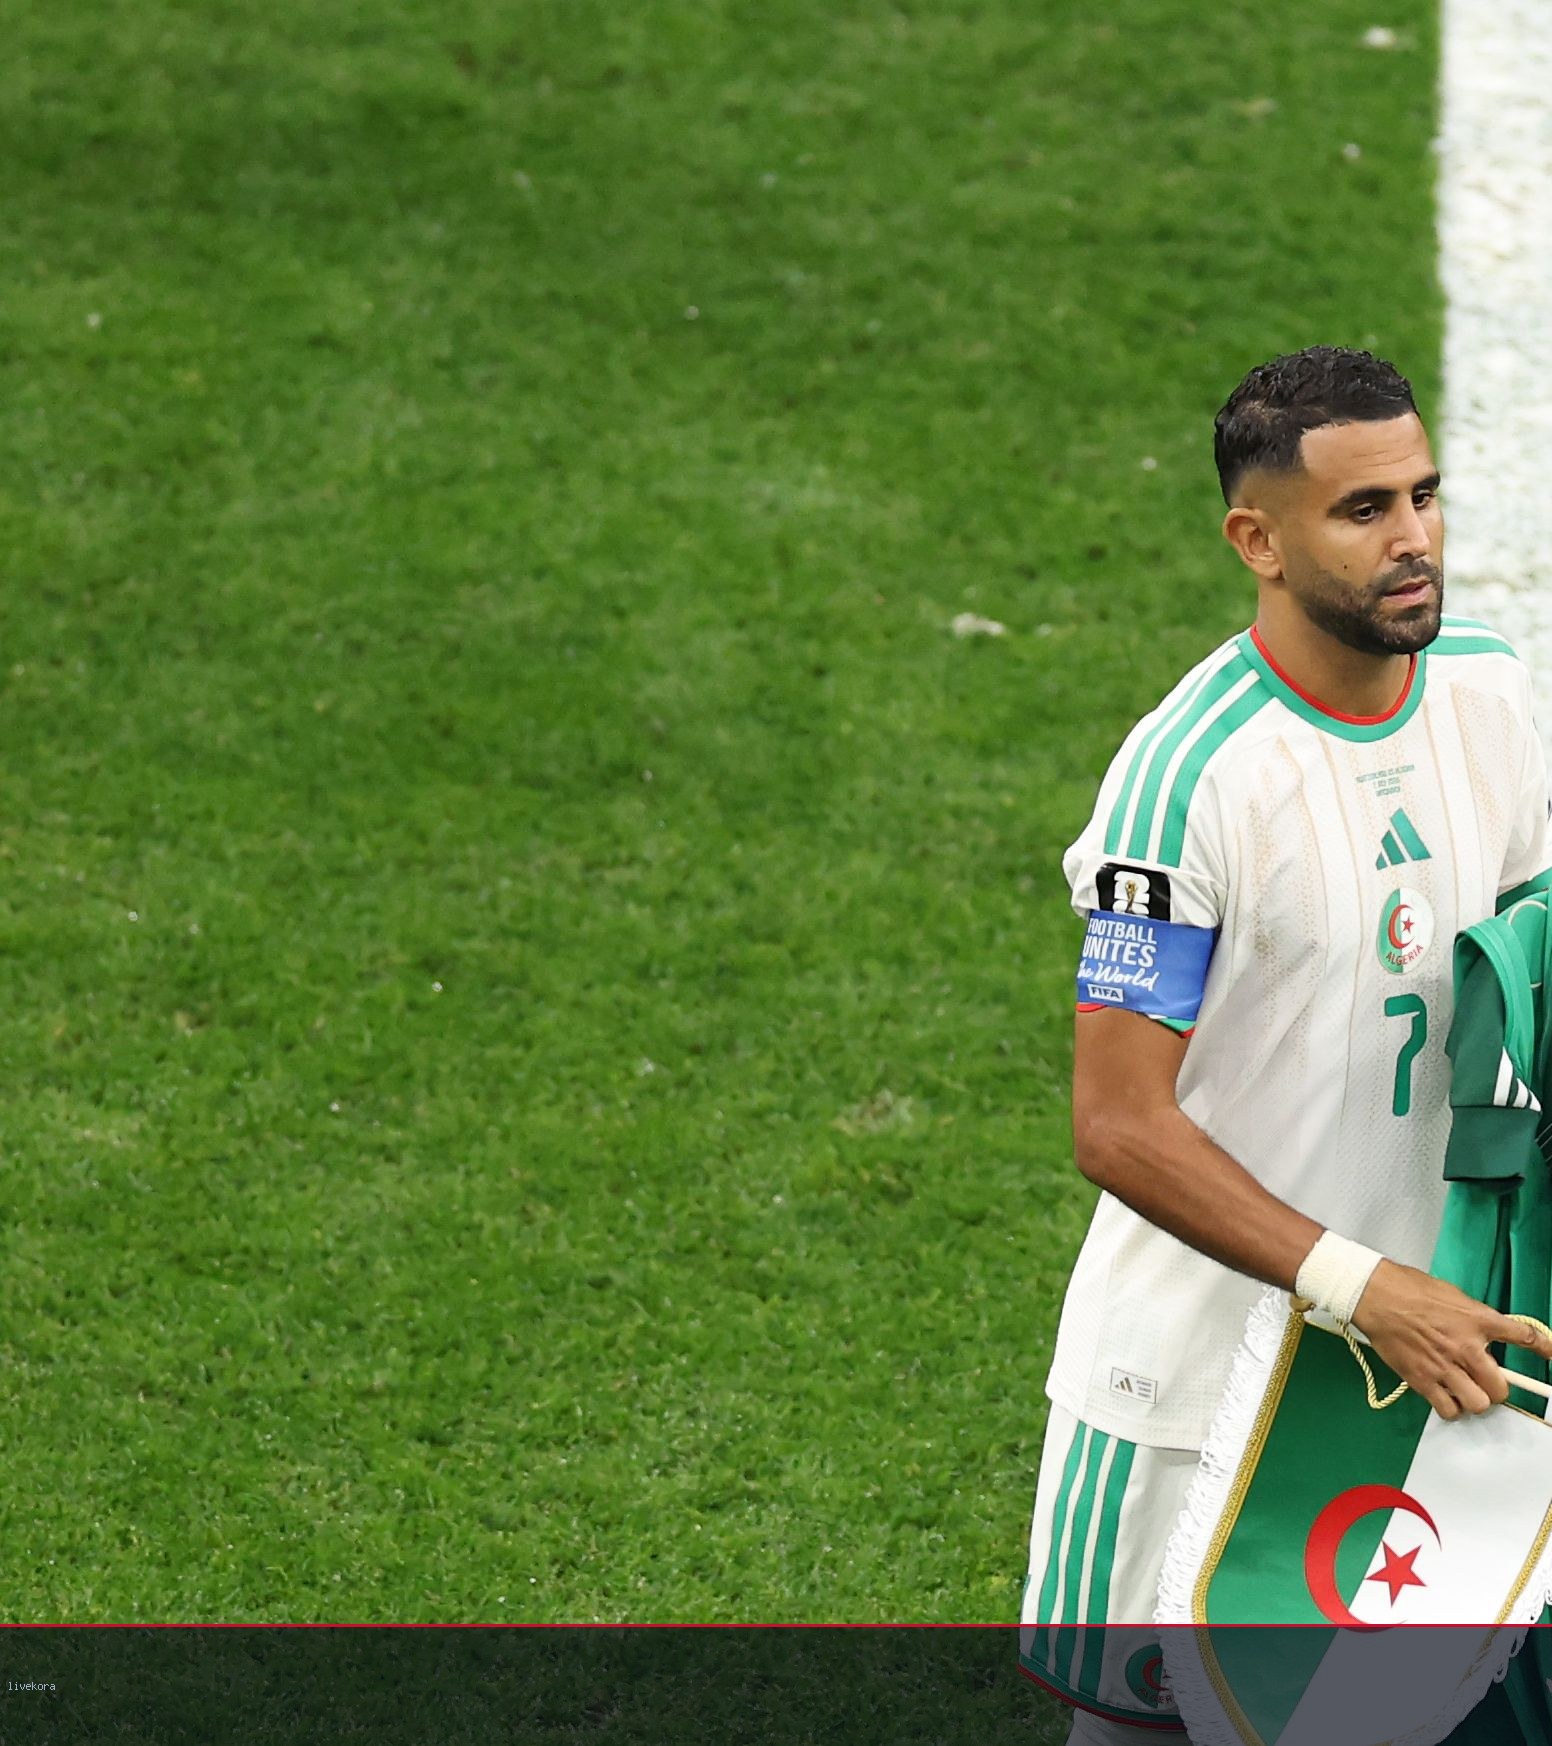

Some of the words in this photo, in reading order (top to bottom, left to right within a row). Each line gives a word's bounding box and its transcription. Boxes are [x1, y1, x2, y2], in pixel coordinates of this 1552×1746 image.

[1087, 917, 1158, 945] FOOTBALL
[1082, 934, 1158, 968] UNITES
[1385, 943, 1424, 966] ALGERIA
[1094, 962, 1160, 992] World
[1090, 985, 1120, 1000] FIFA
[1384, 992, 1428, 1117] 7
